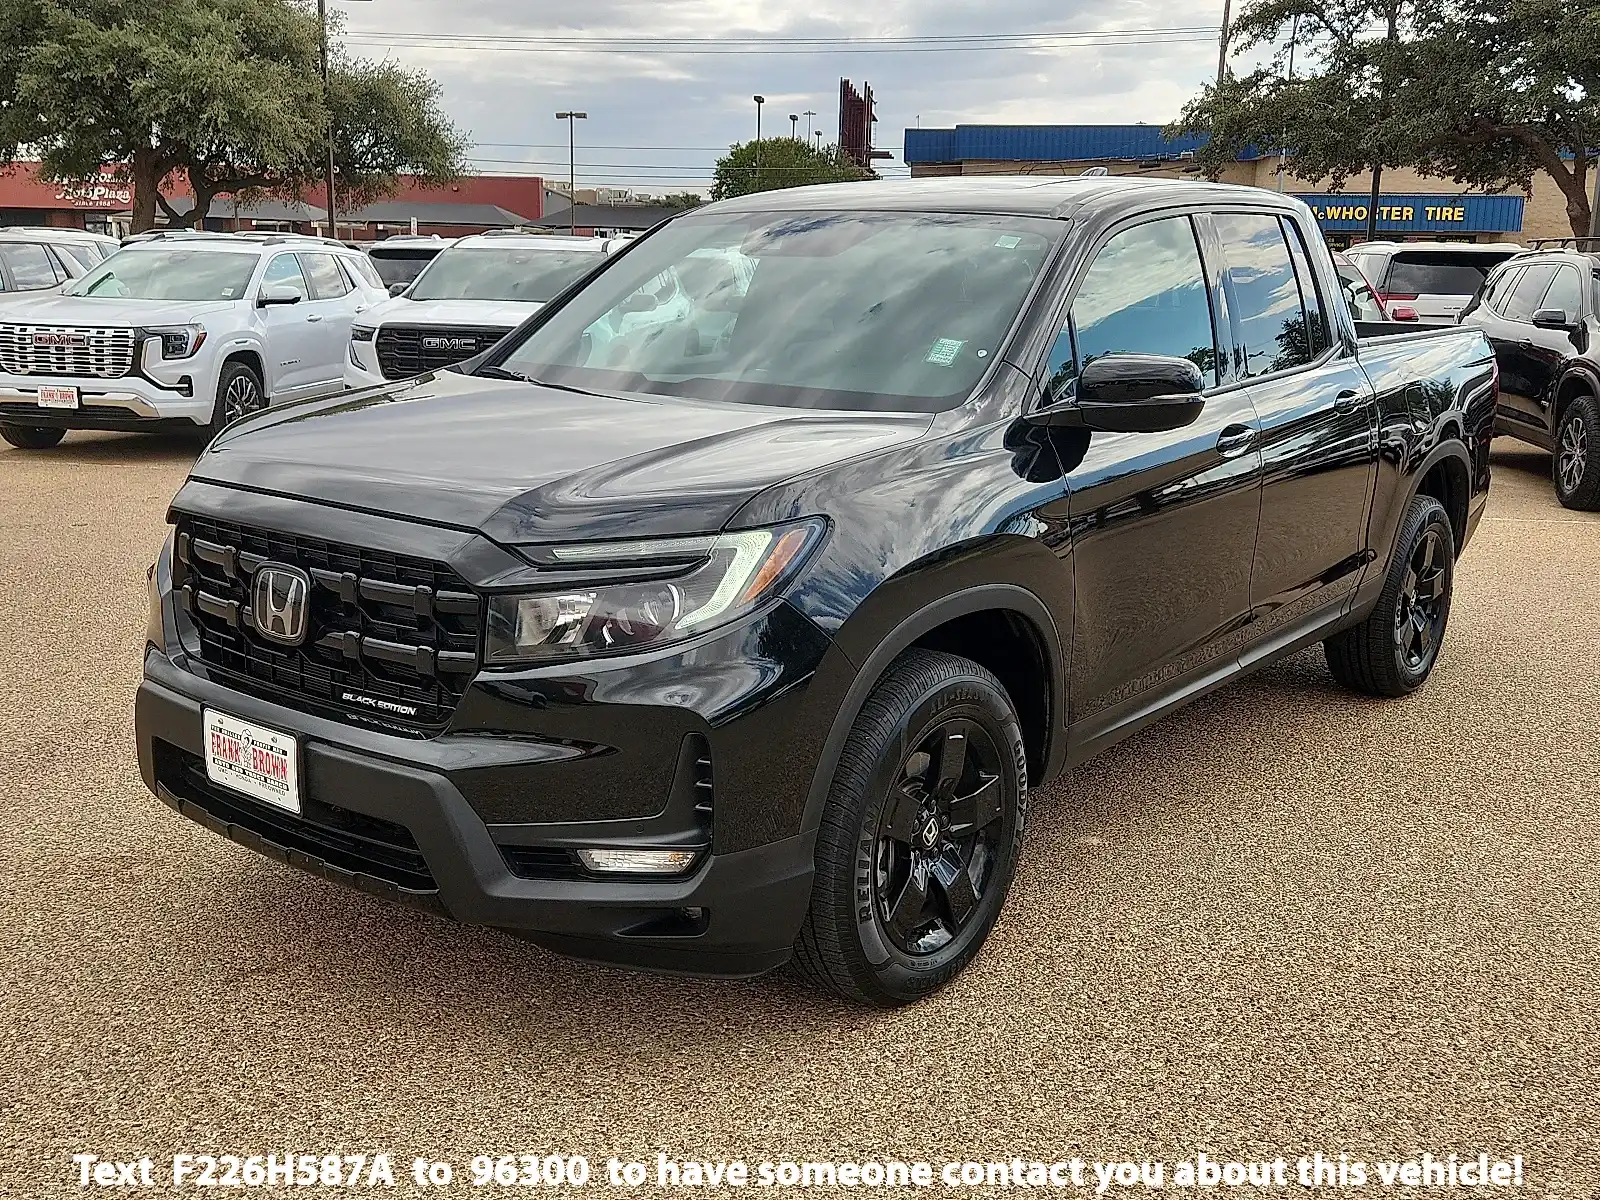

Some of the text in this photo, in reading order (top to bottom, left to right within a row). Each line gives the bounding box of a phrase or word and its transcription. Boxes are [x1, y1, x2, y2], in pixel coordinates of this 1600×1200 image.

[1313, 206, 1465, 221] cWHOTER TIRE
[34, 333, 85, 345] GMC
[423, 337, 476, 350] GMC
[342, 692, 417, 716] BLACK EDITION
[211, 731, 288, 781] FRANK BROWN
